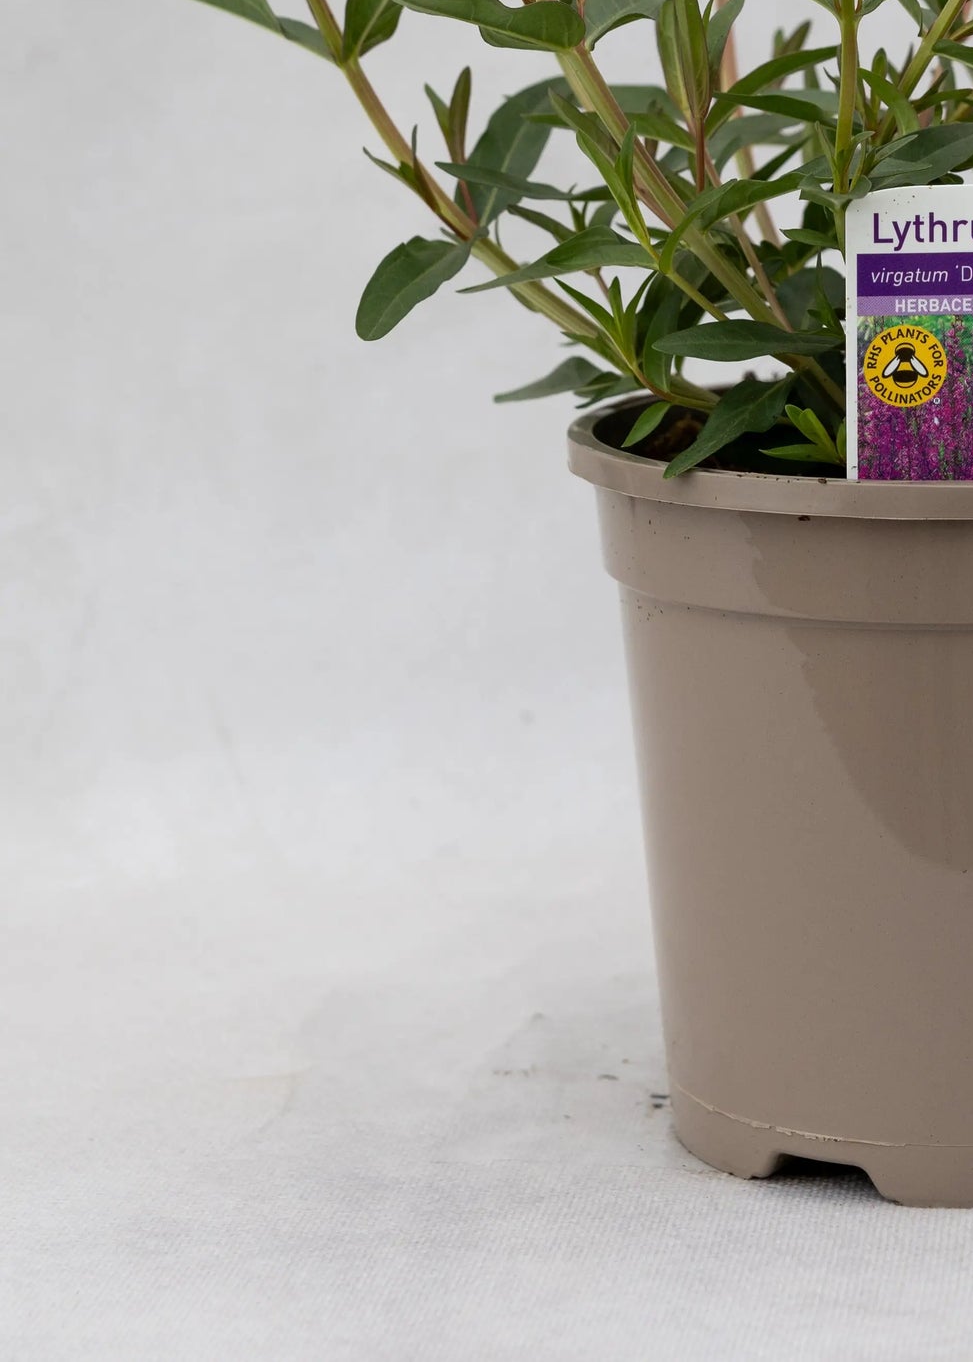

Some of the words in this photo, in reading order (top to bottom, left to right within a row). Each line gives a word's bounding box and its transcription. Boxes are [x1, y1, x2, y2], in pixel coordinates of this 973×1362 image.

[871, 267, 949, 286] virgatum
[867, 345, 882, 369] RHS
[881, 328, 929, 345] PLANTS
[928, 343, 944, 368] FOR
[869, 373, 942, 404] POLLINATORS
